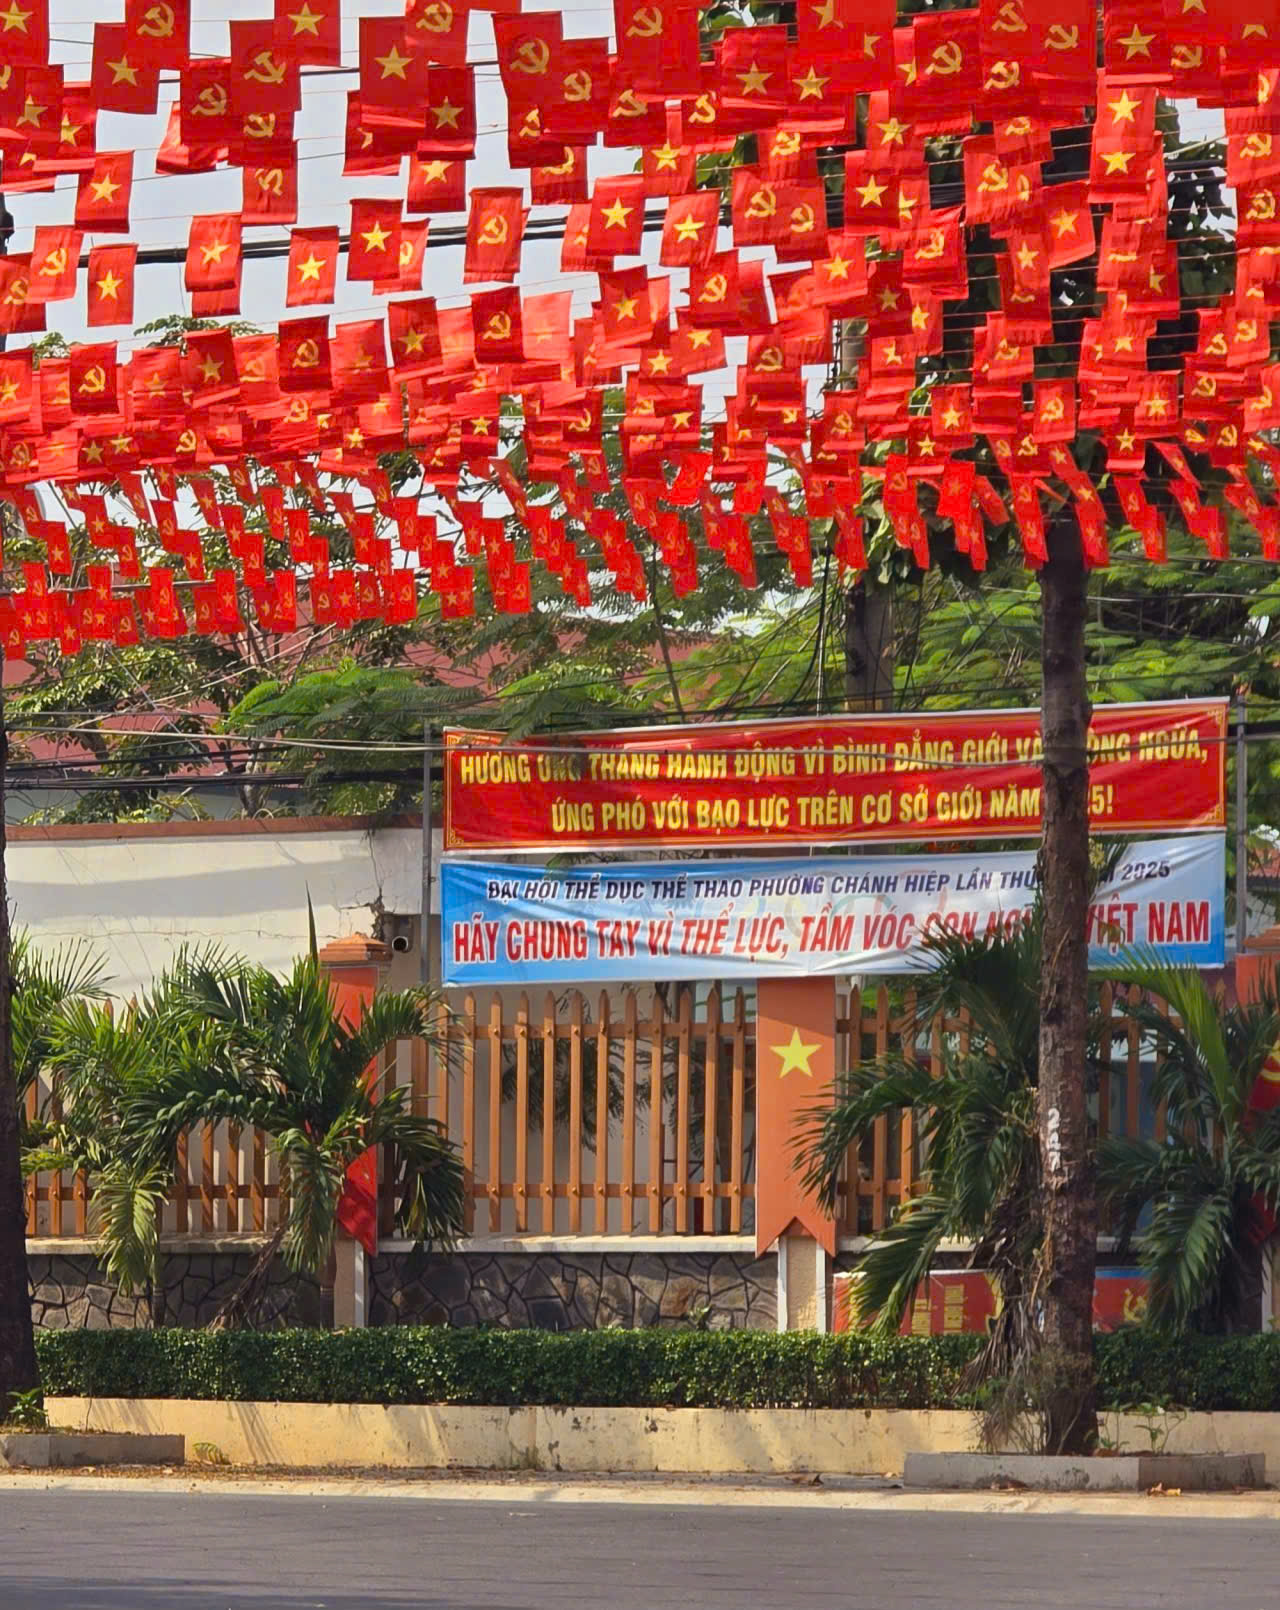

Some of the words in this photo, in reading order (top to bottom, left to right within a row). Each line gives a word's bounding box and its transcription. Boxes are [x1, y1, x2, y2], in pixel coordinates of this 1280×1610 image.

[734, 741, 795, 783] ĐỘNG
[804, 738, 824, 775] VÌ
[833, 737, 887, 773] BÌNH
[894, 729, 954, 772] ĐẲNG
[961, 731, 1008, 766] GIỚI
[551, 796, 594, 832] ỨNG
[602, 795, 646, 830] PHÓ
[652, 794, 689, 829] VỚI
[696, 800, 739, 835] BẠO
[747, 795, 789, 833] LỰC
[797, 789, 853, 826] TRÊN
[861, 790, 892, 823] CƠ
[899, 784, 929, 823] SỞ
[937, 783, 982, 820] GIỚI
[990, 784, 1040, 817] NĂM
[488, 880, 521, 904] ĐẠI
[565, 872, 602, 900] THỂ
[606, 880, 644, 904] DỤC
[651, 874, 688, 900] THỂ
[694, 877, 742, 900] THAO
[745, 874, 825, 899] PHƯỜNG
[831, 868, 897, 895] CHÁNH
[905, 869, 951, 898] HIỆP
[956, 866, 993, 892] LẦN
[454, 912, 500, 963] HÃY
[507, 919, 588, 961] CHUNG
[596, 919, 641, 957] TAY
[648, 911, 675, 956] VÌ
[681, 902, 734, 956] THỂ
[735, 914, 788, 962] LỰC,
[800, 901, 854, 952] TẦM
[862, 905, 915, 949] VÓC
[1147, 901, 1210, 944] NAM
